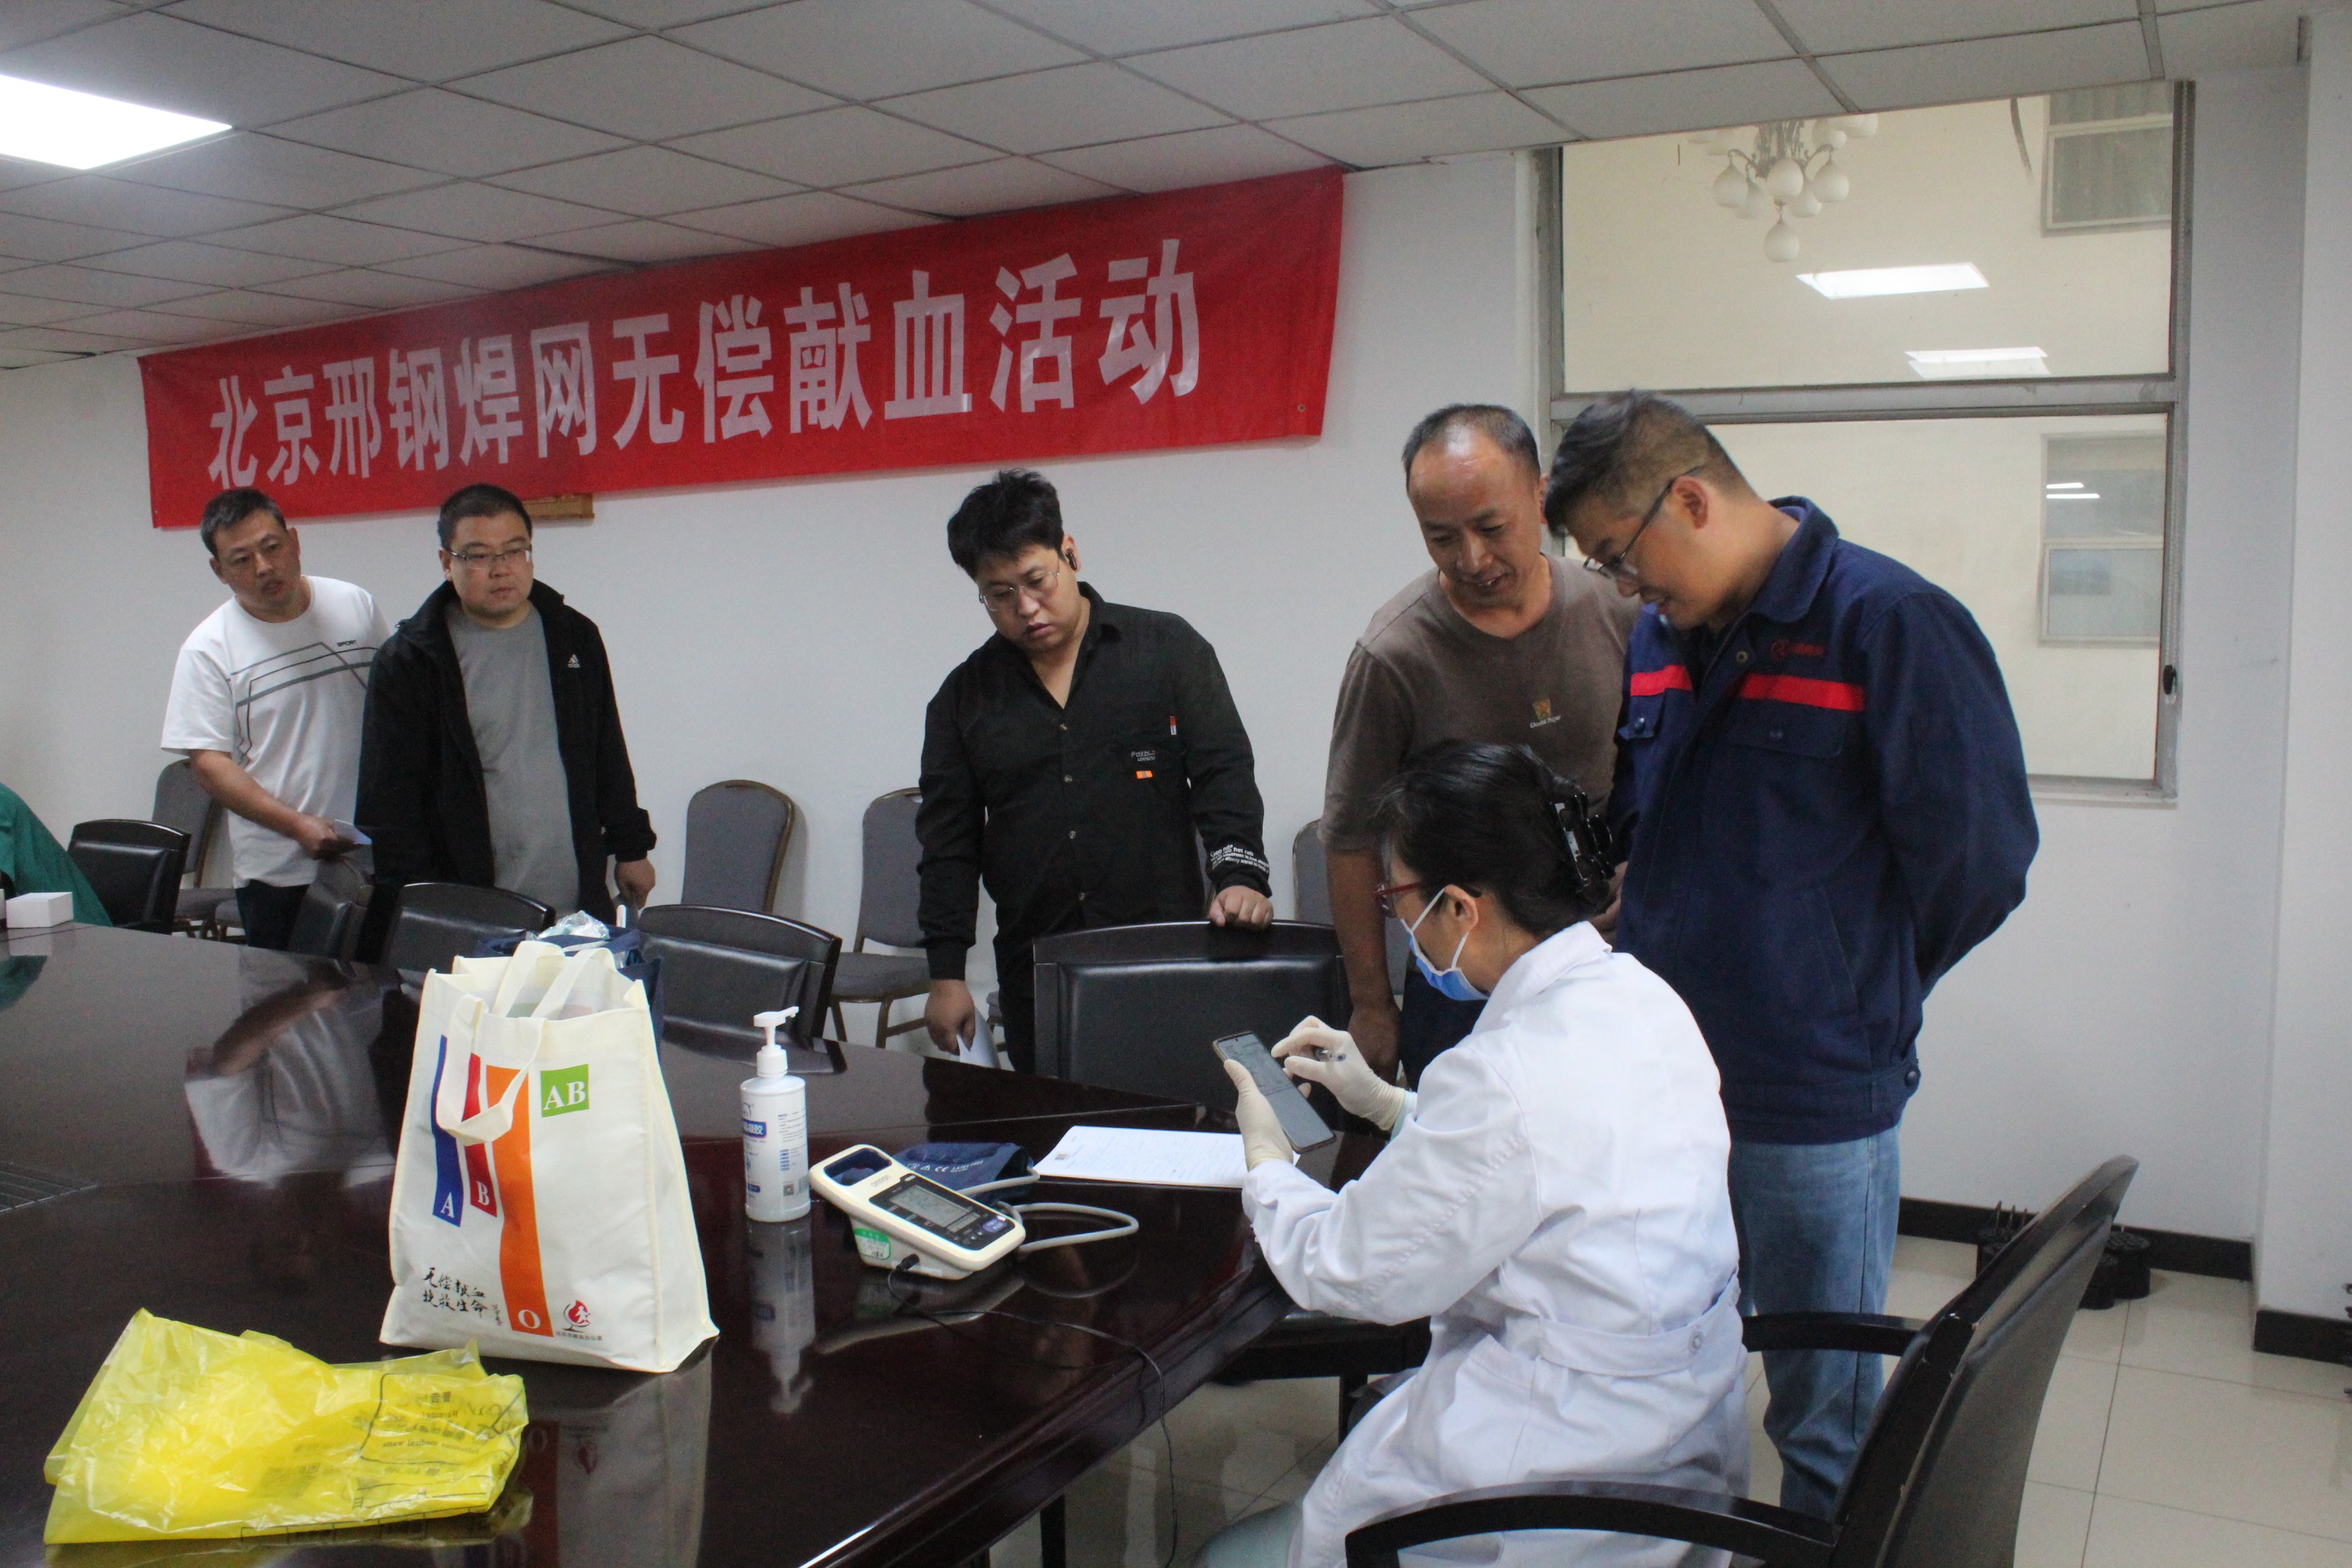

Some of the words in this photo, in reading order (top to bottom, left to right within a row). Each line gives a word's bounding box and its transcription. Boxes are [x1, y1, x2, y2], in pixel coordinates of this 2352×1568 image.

[208, 238, 1200, 489] 北京邢钢焊网无偿献血活动
[543, 1081, 586, 1110] AB
[440, 1192, 455, 1218] A
[476, 1181, 490, 1205] B
[518, 1309, 541, 1329] O
